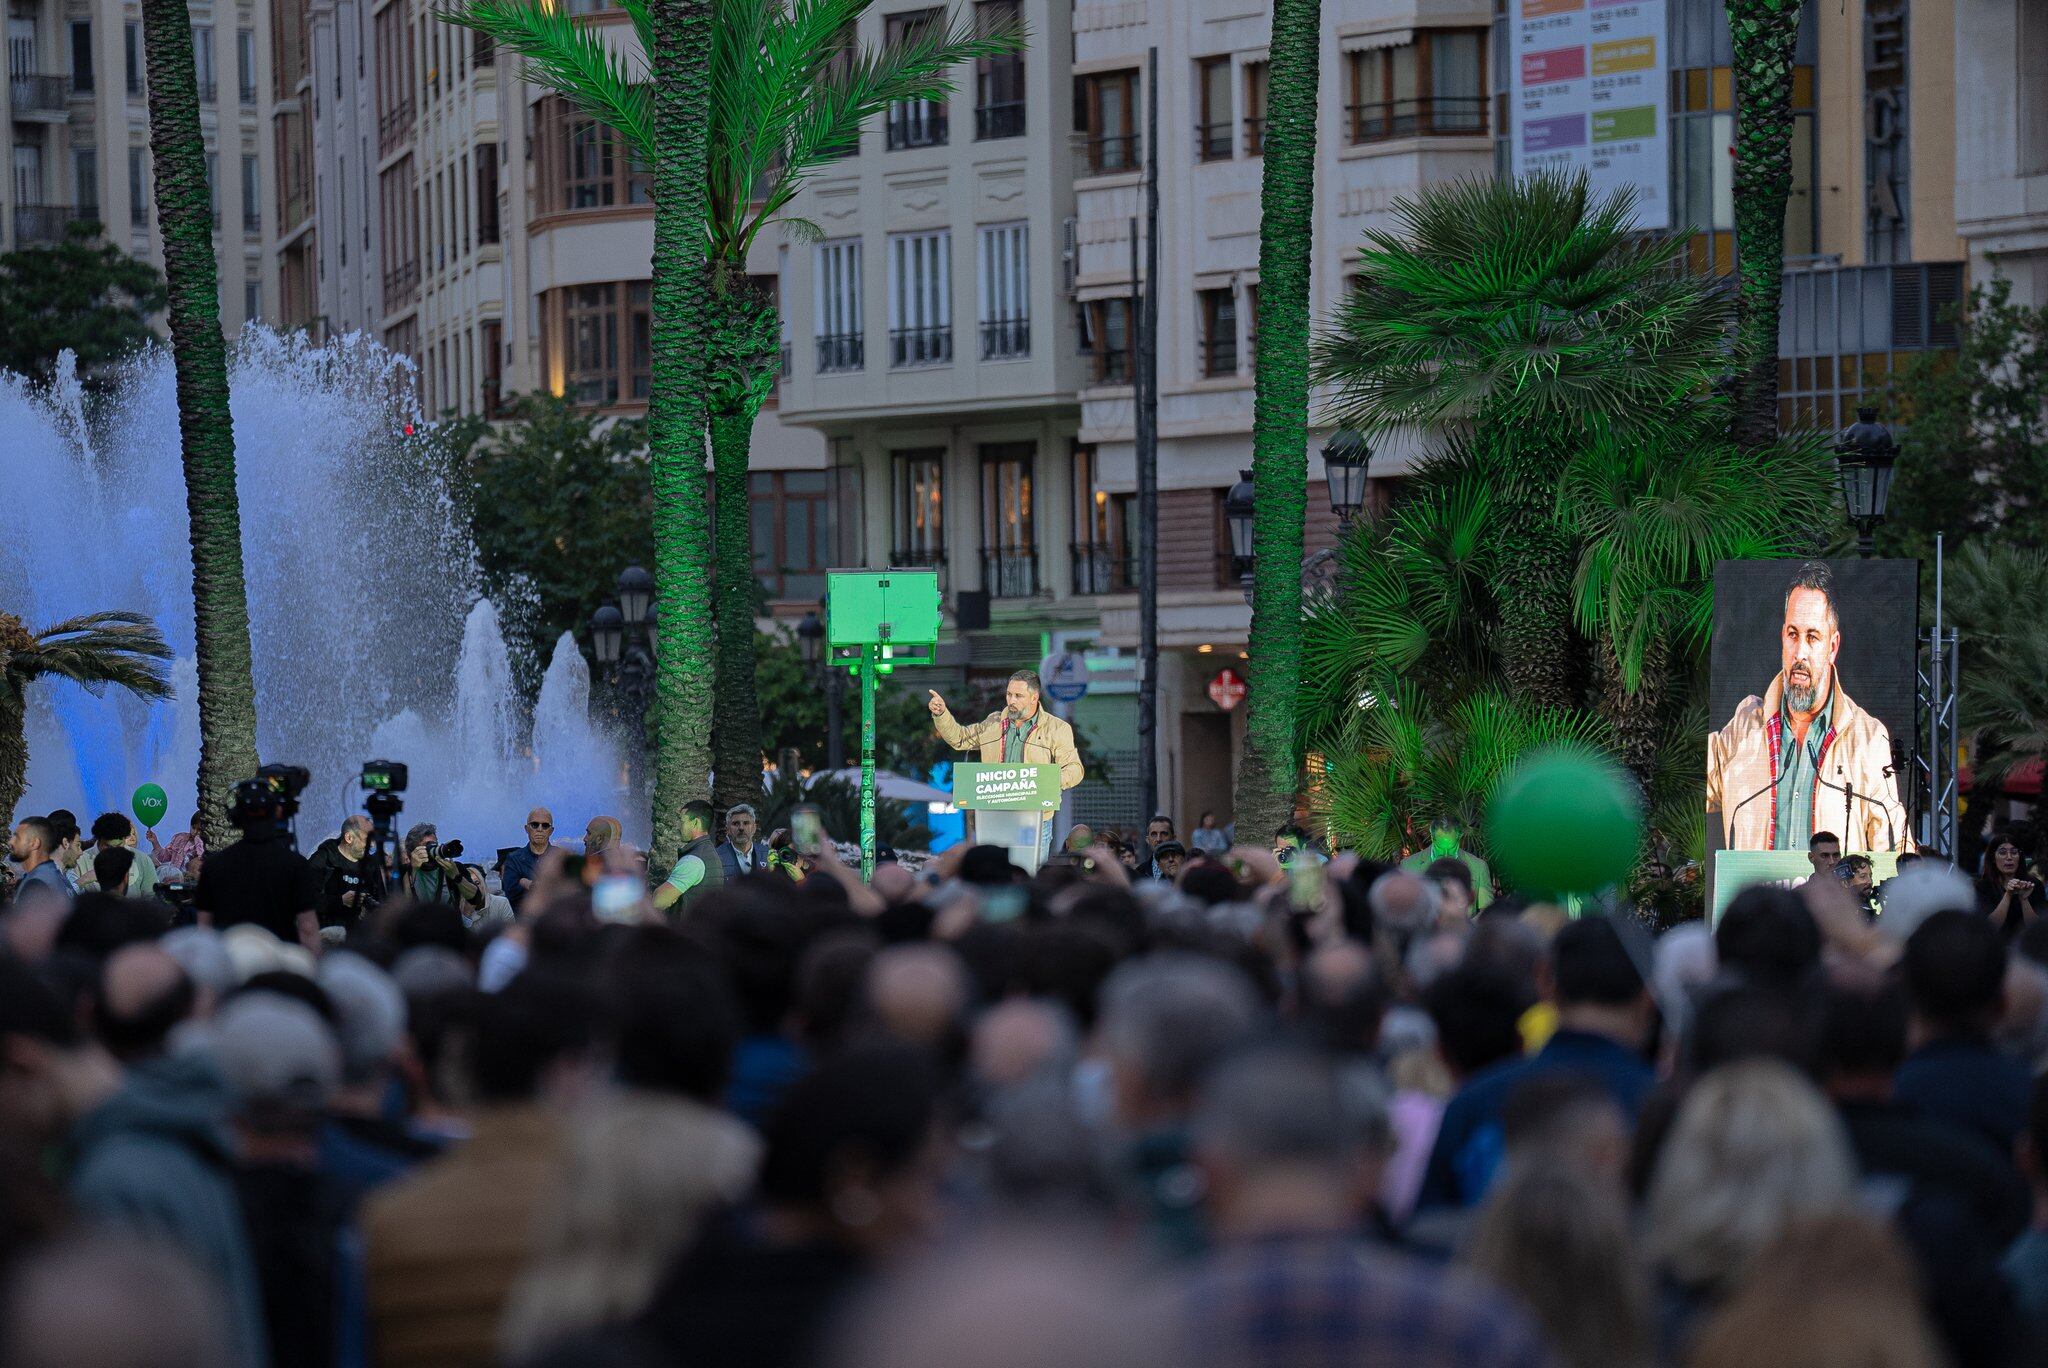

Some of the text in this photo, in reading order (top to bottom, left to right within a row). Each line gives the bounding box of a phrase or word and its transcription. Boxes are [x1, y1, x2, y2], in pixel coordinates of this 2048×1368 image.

[976, 767, 1038, 782] INICIO DE
[976, 778, 1037, 794] CAMPAÑA
[142, 797, 162, 807] VOX
